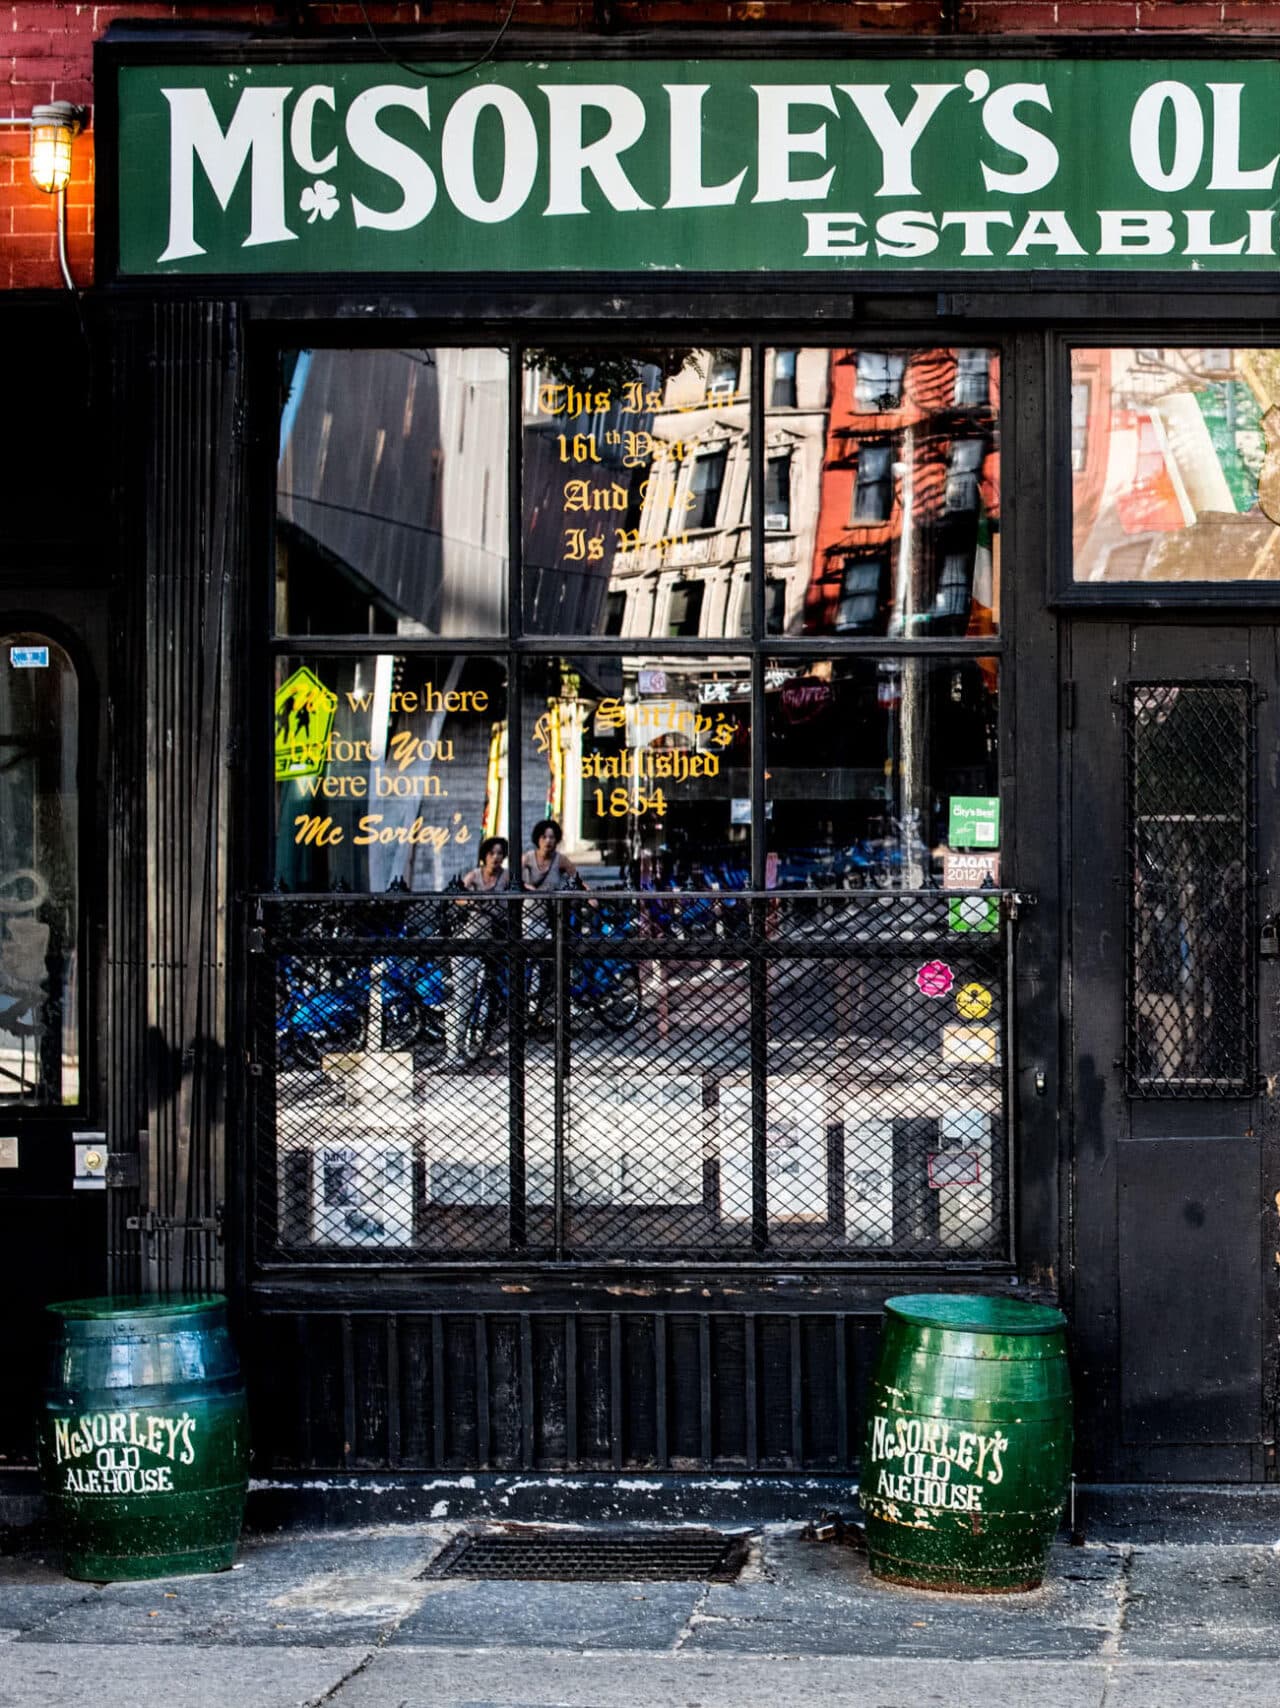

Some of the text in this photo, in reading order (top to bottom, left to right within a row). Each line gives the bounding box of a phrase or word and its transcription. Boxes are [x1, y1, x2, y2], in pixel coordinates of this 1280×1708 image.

[537, 383, 611, 420] This
[620, 381, 663, 414] Is
[563, 480, 629, 512] And
[563, 529, 605, 560] Is
[345, 689, 418, 713] wre
[425, 682, 489, 713] here
[391, 731, 456, 772] You
[557, 748, 720, 783] stablished
[296, 767, 449, 798] were born.
[593, 787, 668, 817] 1854
[294, 811, 473, 848] Mc Sorley's
[947, 857, 995, 868] ZAGAT
[95, 1447, 140, 1471] OLD
[903, 1452, 951, 1482] OLD
